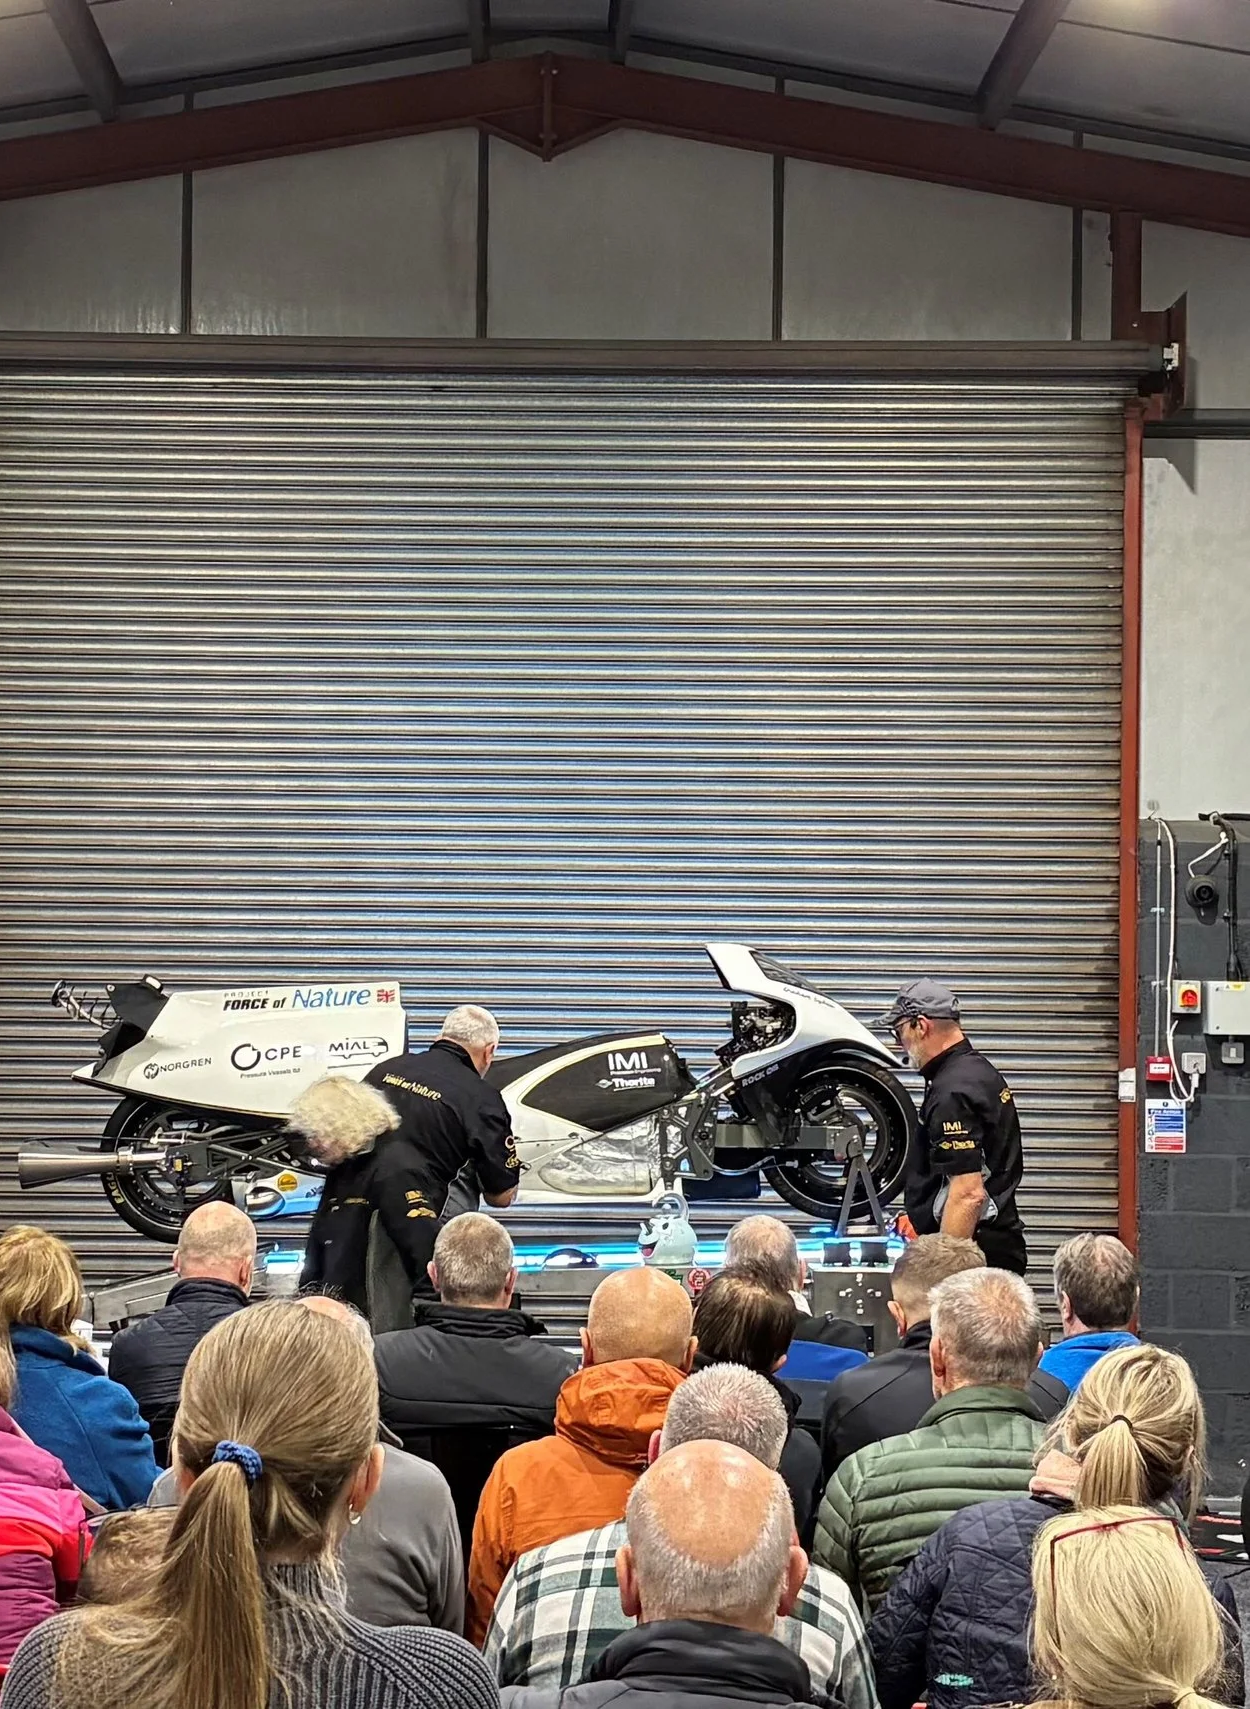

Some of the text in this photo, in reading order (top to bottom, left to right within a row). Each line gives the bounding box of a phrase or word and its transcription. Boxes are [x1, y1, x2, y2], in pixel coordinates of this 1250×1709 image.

[223, 988, 371, 1011] FORCE of Nature
[265, 1045, 302, 1060] CPE
[160, 1057, 212, 1073] NORGREN
[608, 1052, 648, 1070] IMI
[742, 1070, 766, 1087] ROCK
[943, 1121, 962, 1132] IMI
